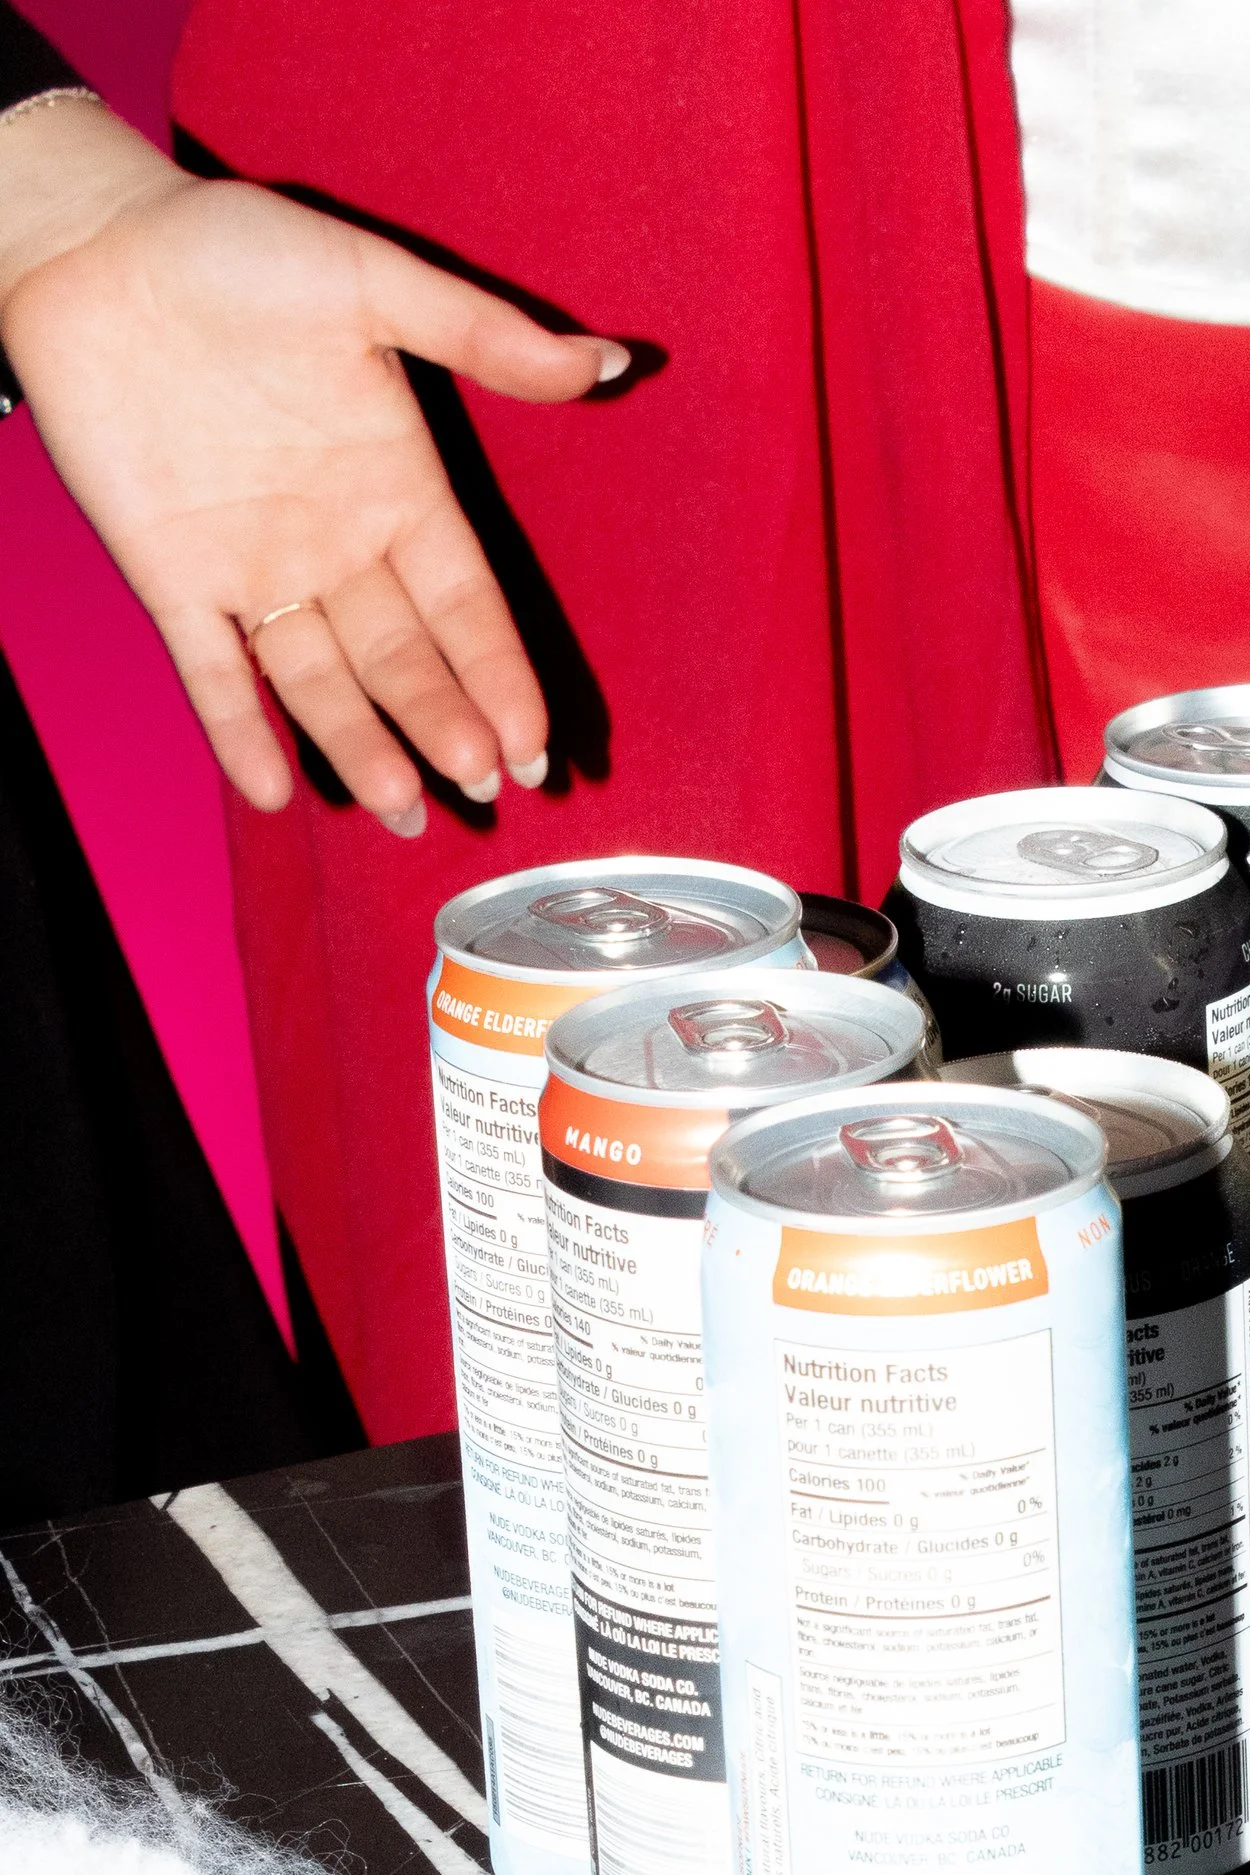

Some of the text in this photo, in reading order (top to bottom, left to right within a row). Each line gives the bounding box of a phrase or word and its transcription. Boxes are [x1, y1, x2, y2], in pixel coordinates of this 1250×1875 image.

[1016, 983, 1072, 1003] SUGAR
[436, 990, 482, 1026] ORANGE
[1211, 1024, 1244, 1045] Valeur
[1212, 1050, 1226, 1063] Per
[438, 1065, 537, 1118] Nutrition Facts
[440, 1096, 471, 1129] Valeur
[564, 1125, 642, 1166] MANGO
[465, 1160, 501, 1181] canette
[476, 1190, 494, 1207] 100
[585, 1215, 630, 1244] Facts
[1077, 1214, 1112, 1249] NON
[573, 1242, 637, 1275] nutritive
[486, 1274, 521, 1298] Sucres
[565, 1283, 596, 1309] canette
[486, 1300, 540, 1326] Protéines
[783, 1353, 949, 1384] Nutrition Facts
[611, 1388, 668, 1414] Glucides
[784, 1384, 957, 1414] Valeur nutritive
[583, 1402, 617, 1429] Sucres
[786, 1412, 855, 1436] Per can
[1162, 1417, 1191, 1432] valeur
[583, 1429, 634, 1461] Protéines
[788, 1439, 898, 1462] pour canette
[789, 1467, 886, 1493] Calories 100
[791, 1502, 888, 1529] Fat Lipides
[792, 1529, 989, 1555] Carbohydrate Glucides
[867, 1566, 922, 1583] Sucres
[795, 1585, 945, 1611] Protein Protéines
[598, 1603, 632, 1627] REFUND
[633, 1613, 674, 1639] WHERE
[612, 1625, 626, 1645] OÙ
[627, 1633, 642, 1650] LA
[642, 1637, 661, 1655] LOI
[661, 1642, 678, 1659] LE
[608, 1658, 640, 1684] VODKA
[641, 1673, 674, 1693] SODA
[1208, 1663, 1230, 1678] Citric
[655, 1695, 712, 1717] CANADA
[1163, 1685, 1211, 1705] Potassium
[592, 1701, 705, 1752] NUDEBEVERAGES.COM
[996, 1731, 1039, 1748] beaucoup
[599, 1724, 694, 1768] @NUDEBEVERAGES
[1153, 1740, 1190, 1755] Sorbate
[801, 1754, 1064, 1783] RETURN APPLICABLE
[995, 1776, 1055, 1801] PRESCRIT
[947, 1828, 988, 1845] SODA
[1190, 1817, 1245, 1853] 00172
[966, 1843, 1026, 1864] CANADA
